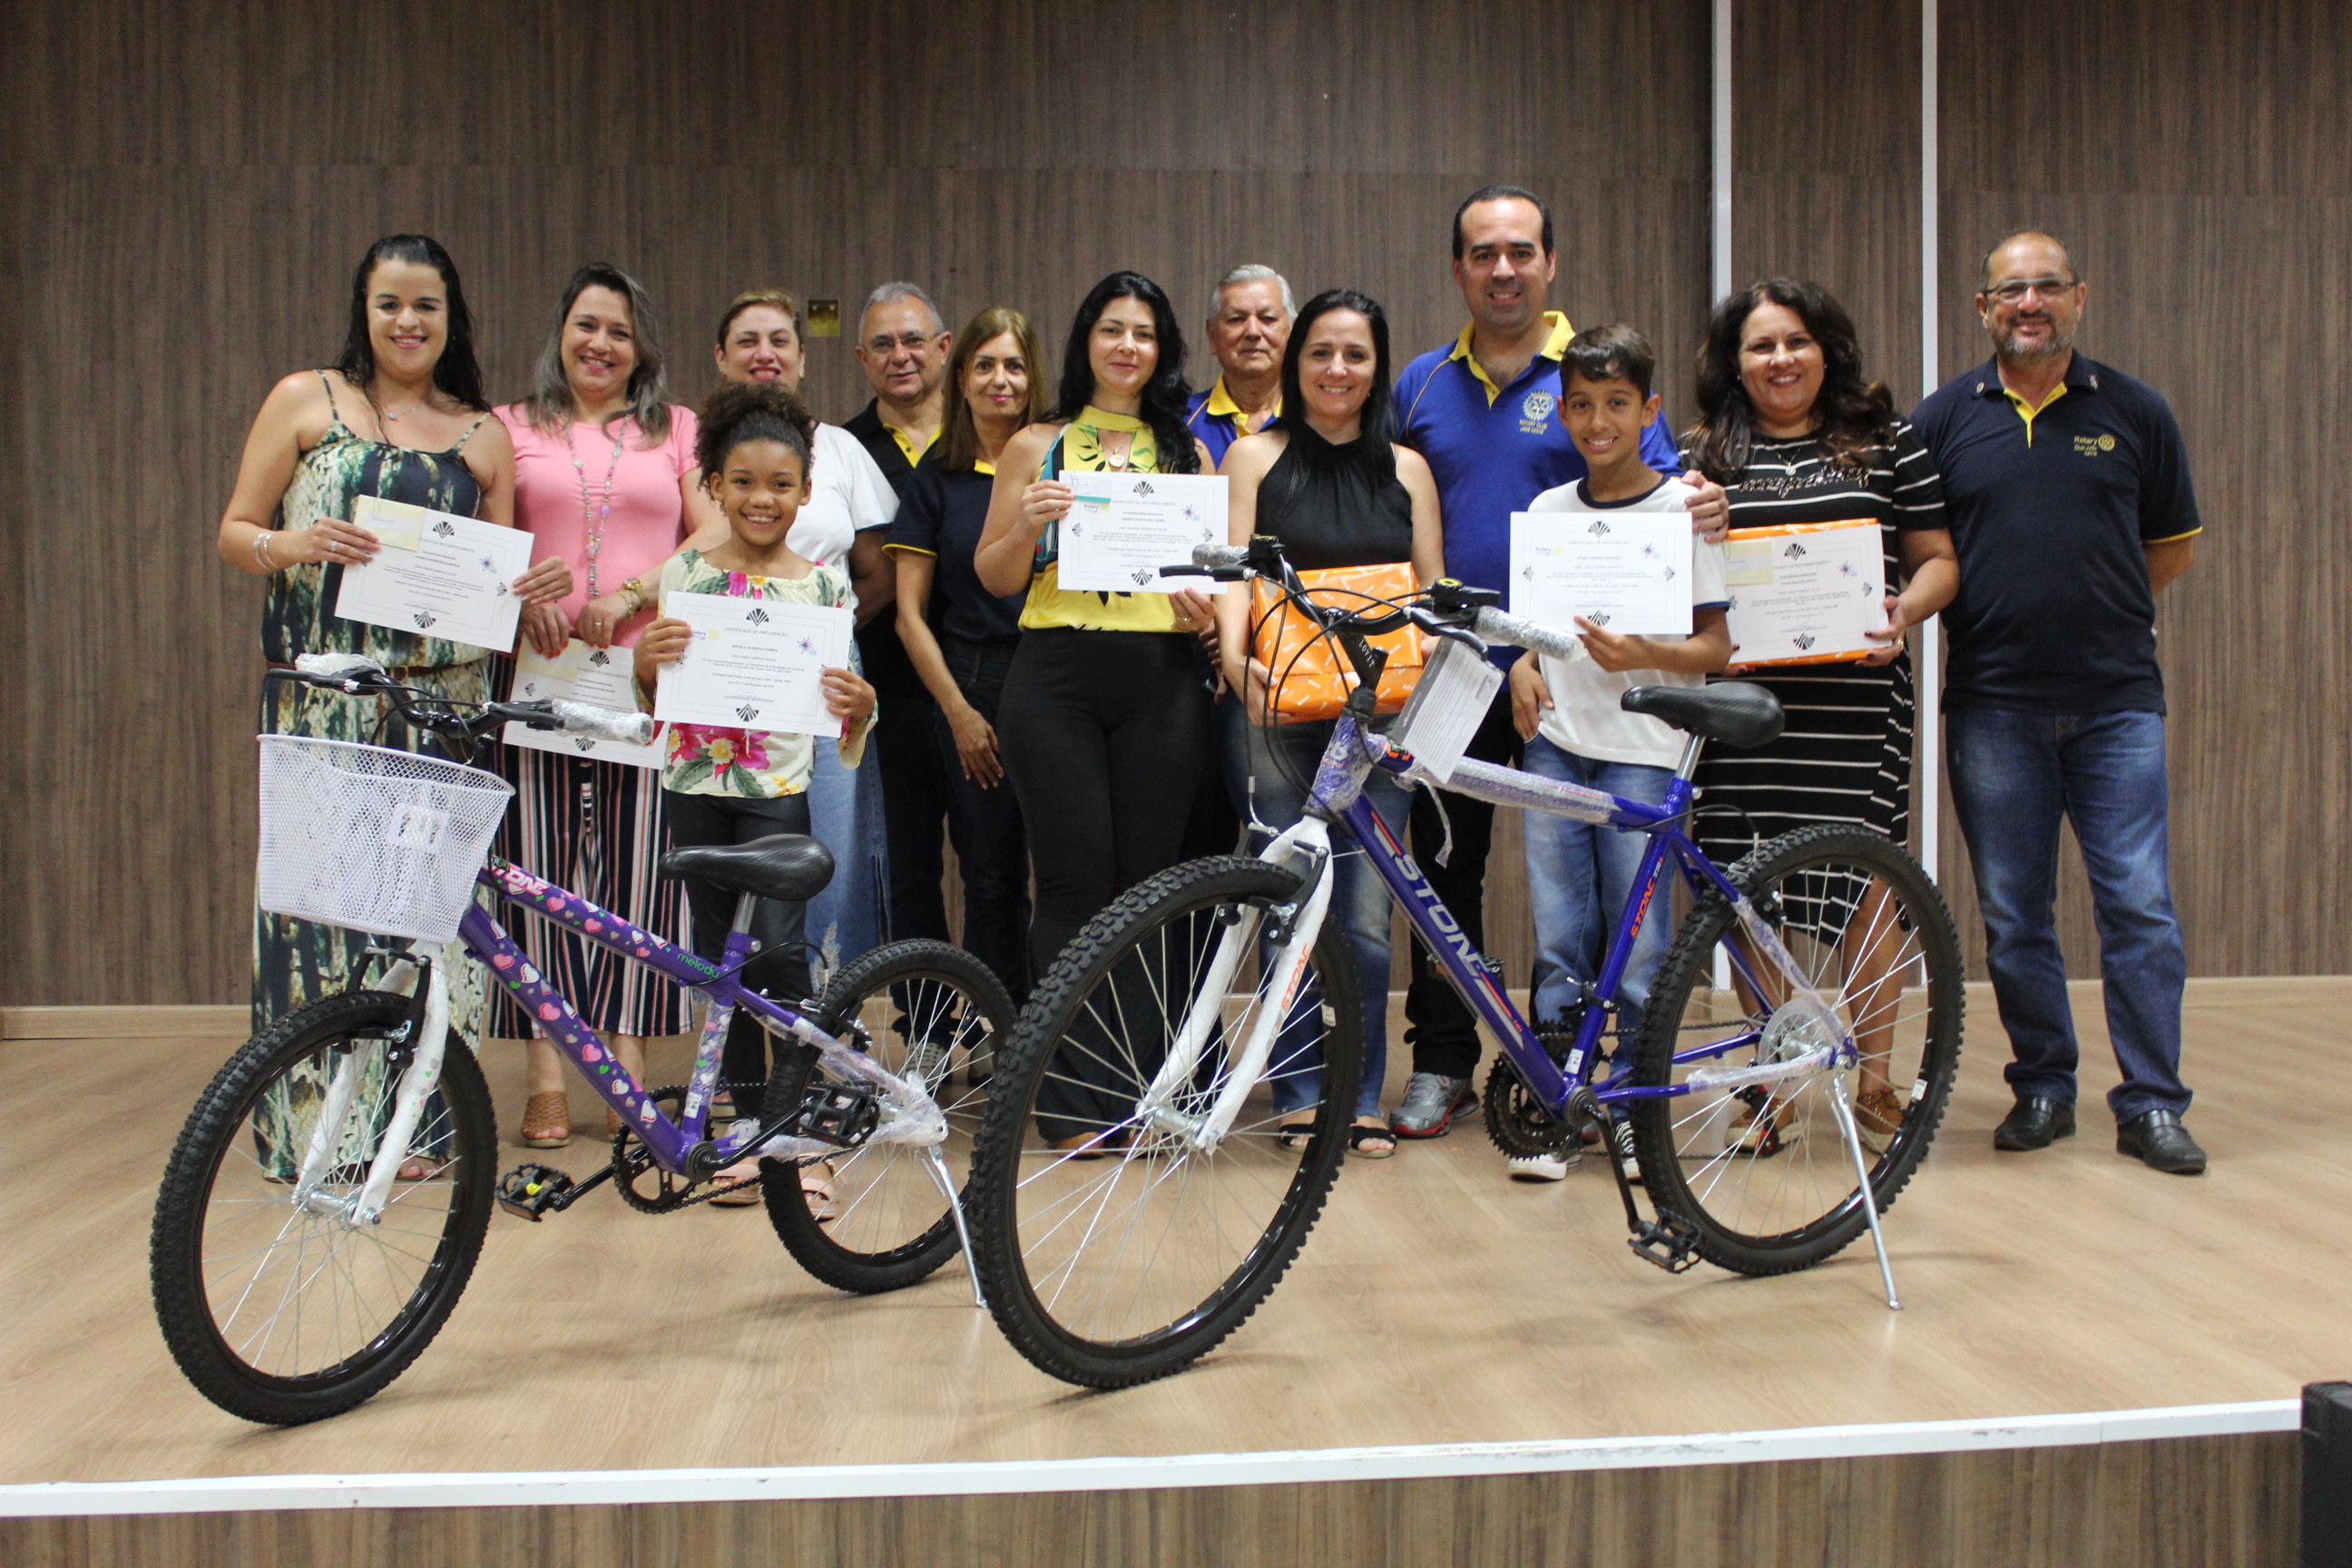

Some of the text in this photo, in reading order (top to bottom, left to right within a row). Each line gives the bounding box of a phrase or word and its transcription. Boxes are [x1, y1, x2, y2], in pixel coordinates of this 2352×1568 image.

[2074, 436, 2098, 446] Rotary
[482, 862, 550, 897] ONE
[1395, 854, 1491, 977] STONE
[677, 953, 720, 980] melody
[1280, 943, 1310, 1013] STONE
